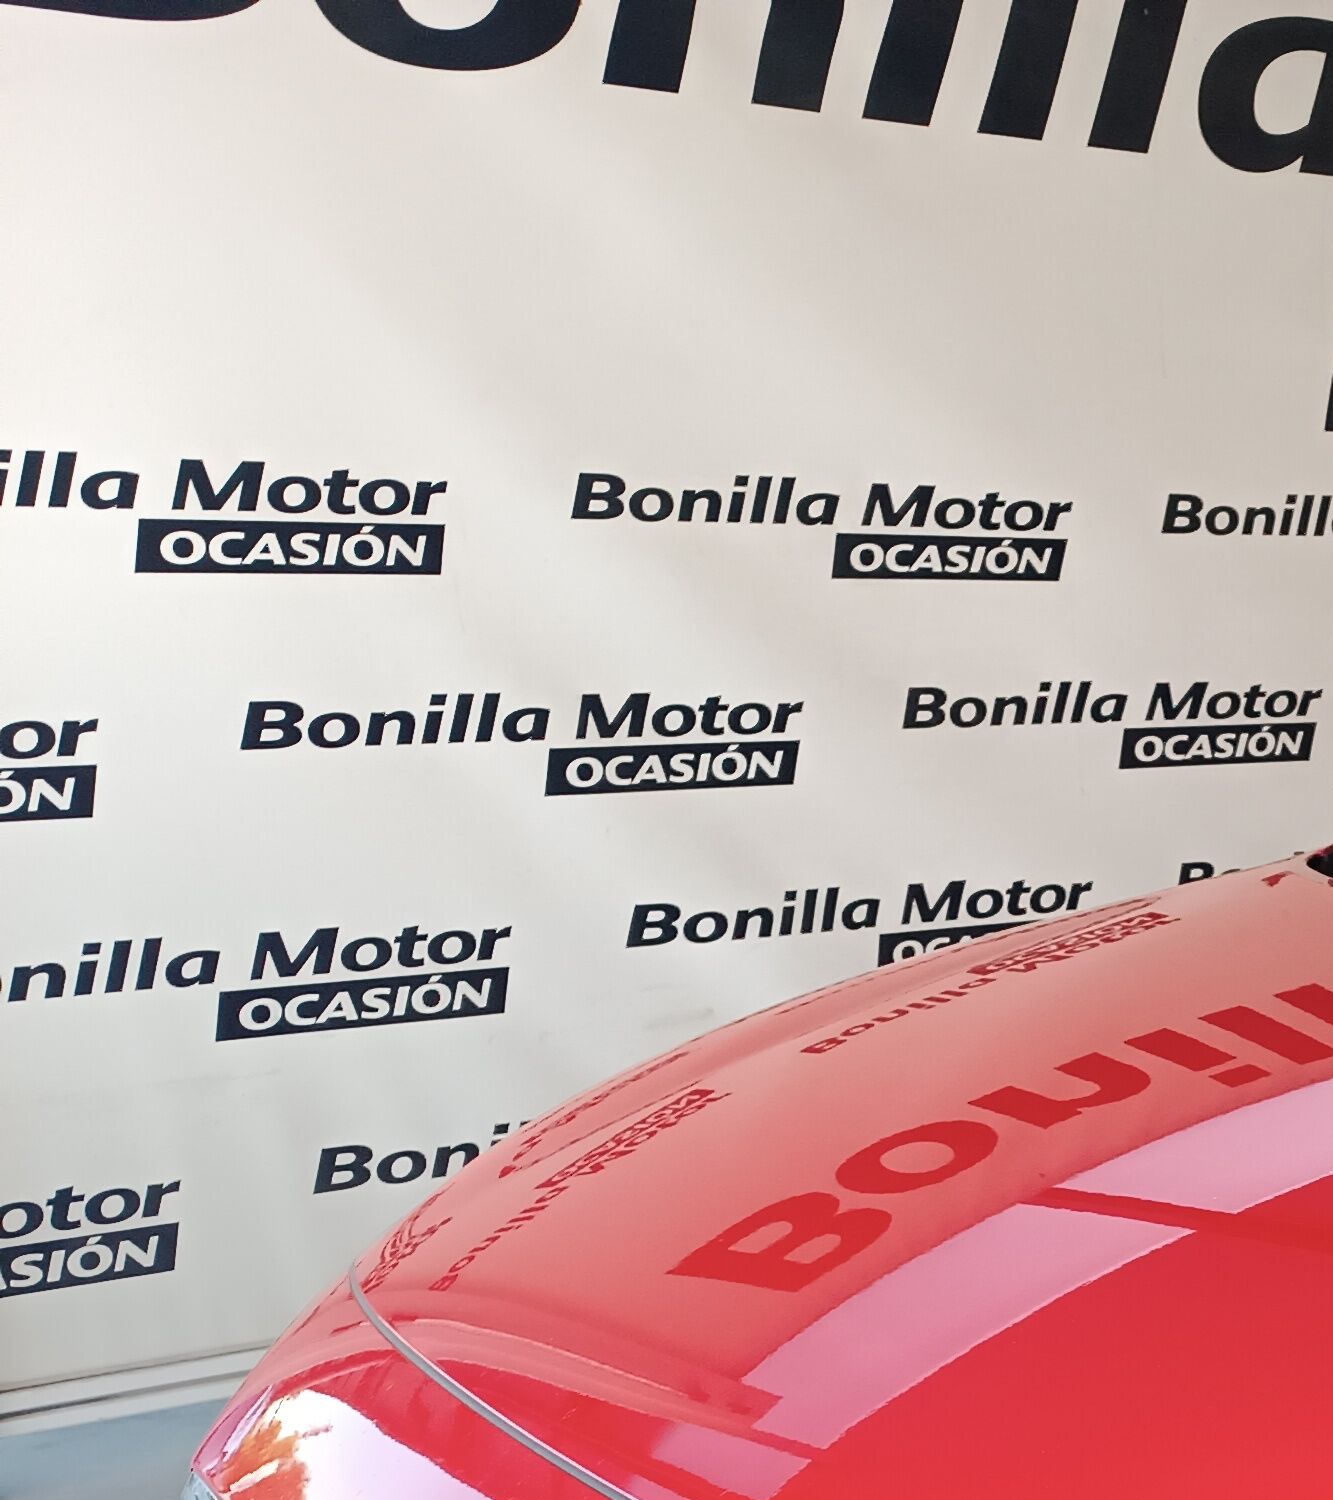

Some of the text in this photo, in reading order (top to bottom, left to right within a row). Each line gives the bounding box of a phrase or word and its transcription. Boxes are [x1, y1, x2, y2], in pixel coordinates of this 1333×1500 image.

[171, 459, 447, 515] Motor
[570, 473, 1073, 531] Bonilla Motor
[159, 524, 427, 567] OCASIÓN
[849, 539, 1053, 575] OCASIÓN
[240, 692, 804, 750] Bonilla Motor
[902, 680, 1323, 729] Bonilla Motor
[565, 745, 784, 788] OCASIÓN
[1134, 726, 1304, 762] OCASIÓN
[626, 880, 1094, 948] Bonilla Motor
[0, 926, 513, 1002] nilla Motor
[238, 975, 493, 1031] OCASIÓN
[0, 1234, 160, 1290] SIÓN
